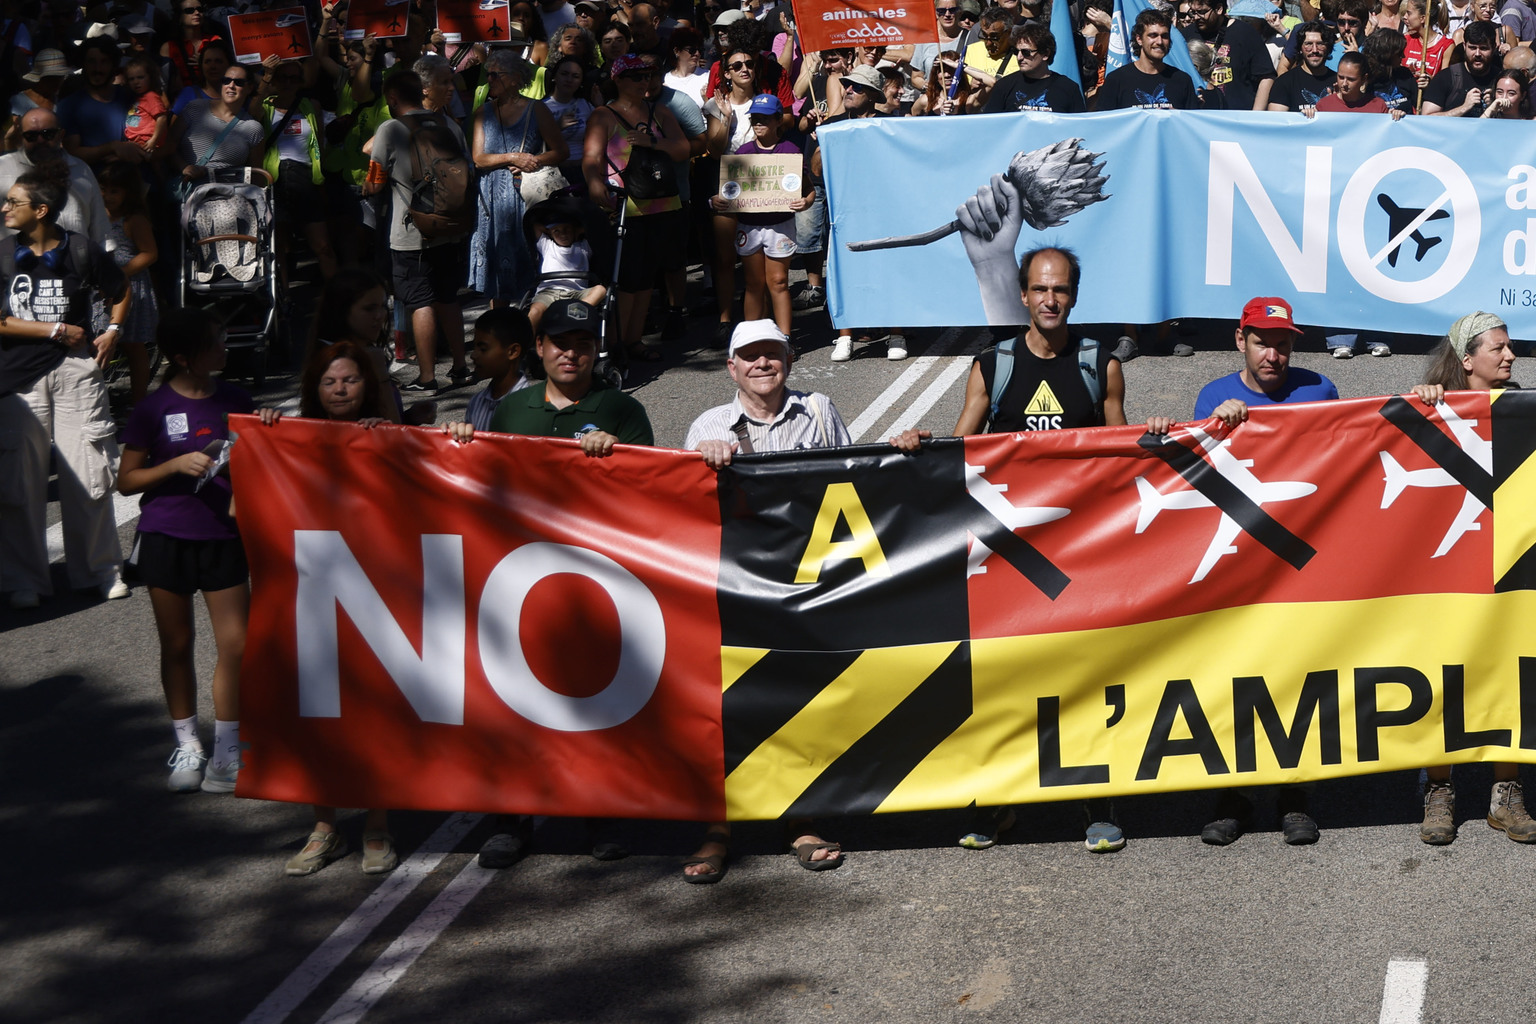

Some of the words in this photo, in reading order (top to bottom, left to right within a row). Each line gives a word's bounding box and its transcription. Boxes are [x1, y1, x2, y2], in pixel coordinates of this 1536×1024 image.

[822, 5, 907, 22] animales
[847, 22, 902, 38] adda
[741, 179, 780, 192] DELTA
[1205, 141, 1481, 304] NO
[1500, 288, 1516, 306] Ni
[1024, 415, 1063, 432] SOS
[794, 482, 892, 584] A
[294, 530, 667, 732] NO
